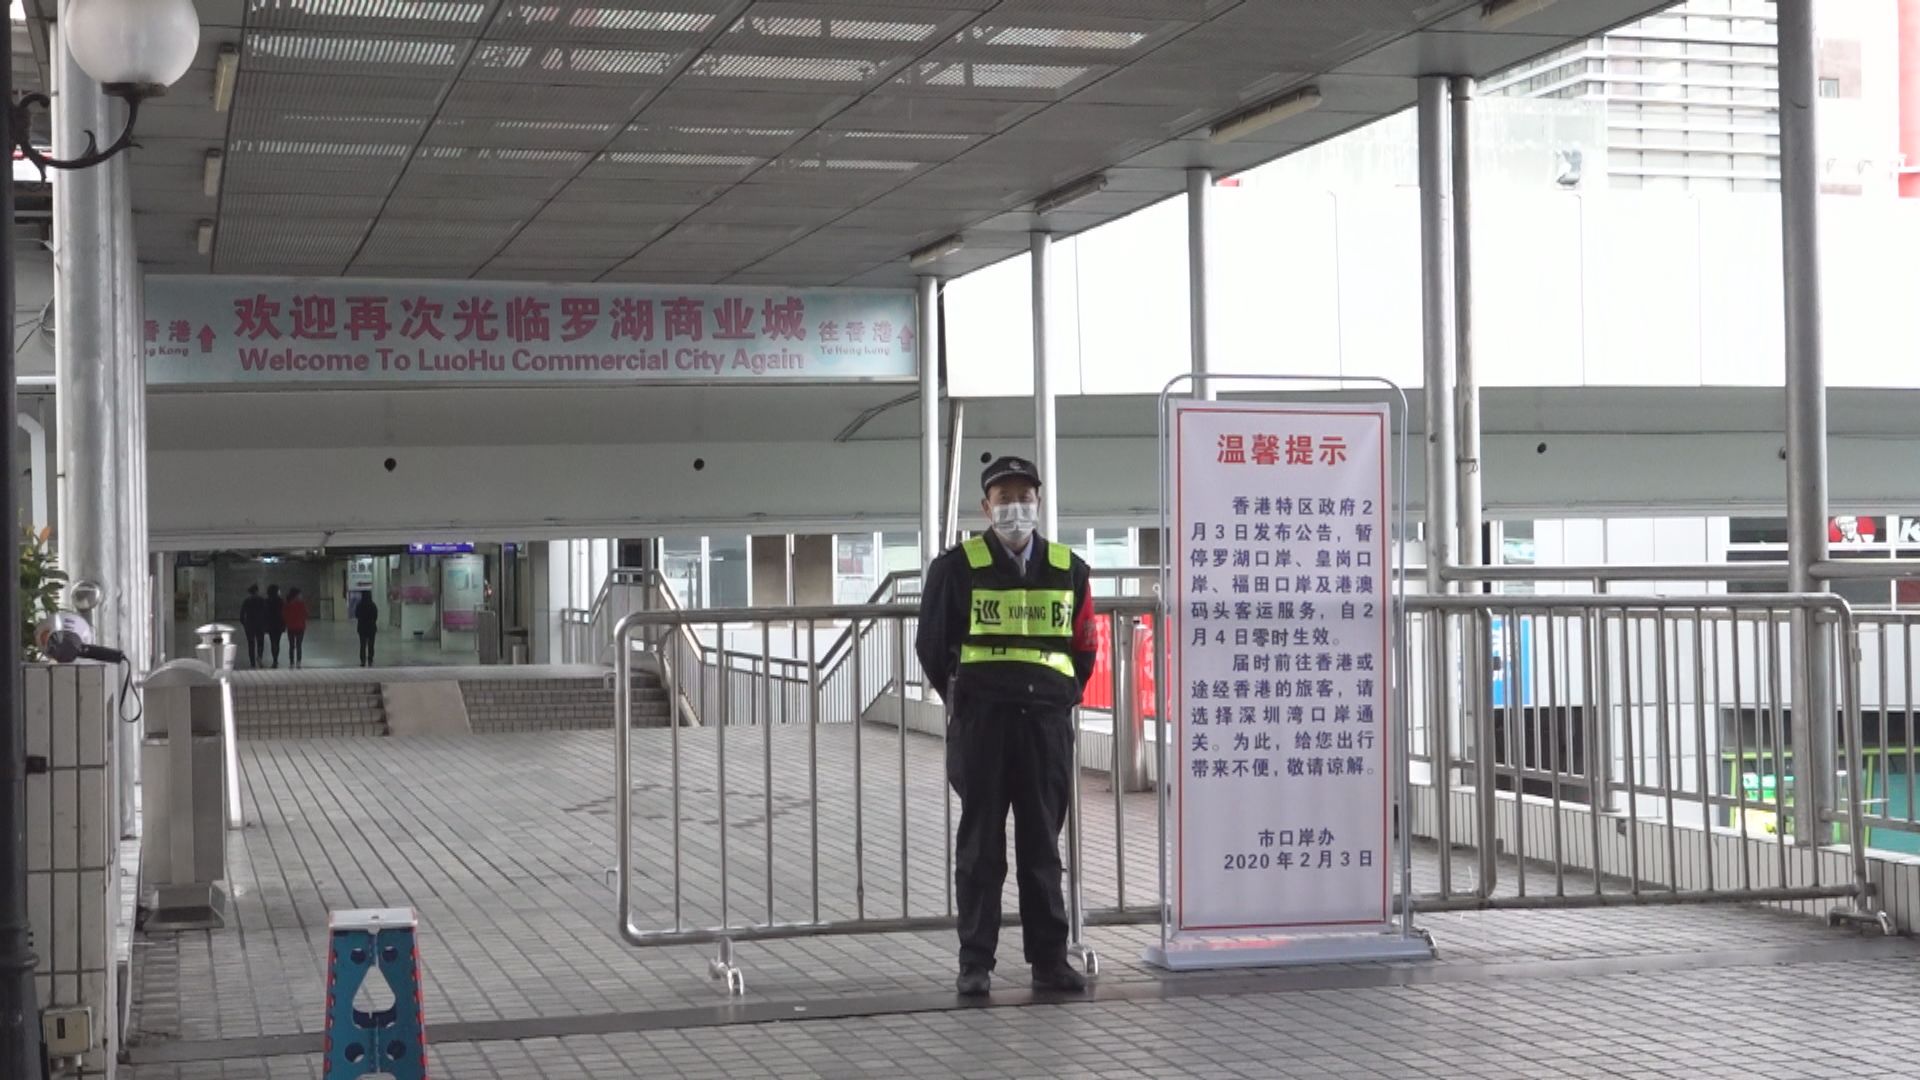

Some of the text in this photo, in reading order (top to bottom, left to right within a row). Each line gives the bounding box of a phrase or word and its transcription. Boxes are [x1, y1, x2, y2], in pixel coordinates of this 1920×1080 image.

[233, 294, 806, 343] 欢迎再次光临罗湖商业城
[818, 320, 893, 343] 往香港
[158, 346, 189, 357] Kong
[238, 347, 805, 375] Welcome To LuoHu Commercial City Again
[1216, 434, 1347, 465] 温馨提示
[1232, 496, 1373, 517] 香港特区政府2
[1191, 522, 1373, 542] 月3日发布公告，暂
[1190, 548, 1372, 568] 停罗湖口岸、皇岗口
[1191, 574, 1374, 594] 岸、福田口岸及港澳
[974, 599, 1002, 626] 巡
[1191, 601, 1374, 621] 码头客运服务，自2
[1191, 627, 1340, 647] 月4日零时生效。
[1232, 653, 1374, 673] 届时前往香港或
[1191, 679, 1374, 699] 途经香港的旅客，请
[1191, 704, 1374, 725] 选择深圳湾口岸通
[1191, 730, 1375, 752] 关。为此，给您出行
[1191, 756, 1374, 778] 带来不便，敬请谅解。
[1258, 828, 1335, 847] 市口岸办
